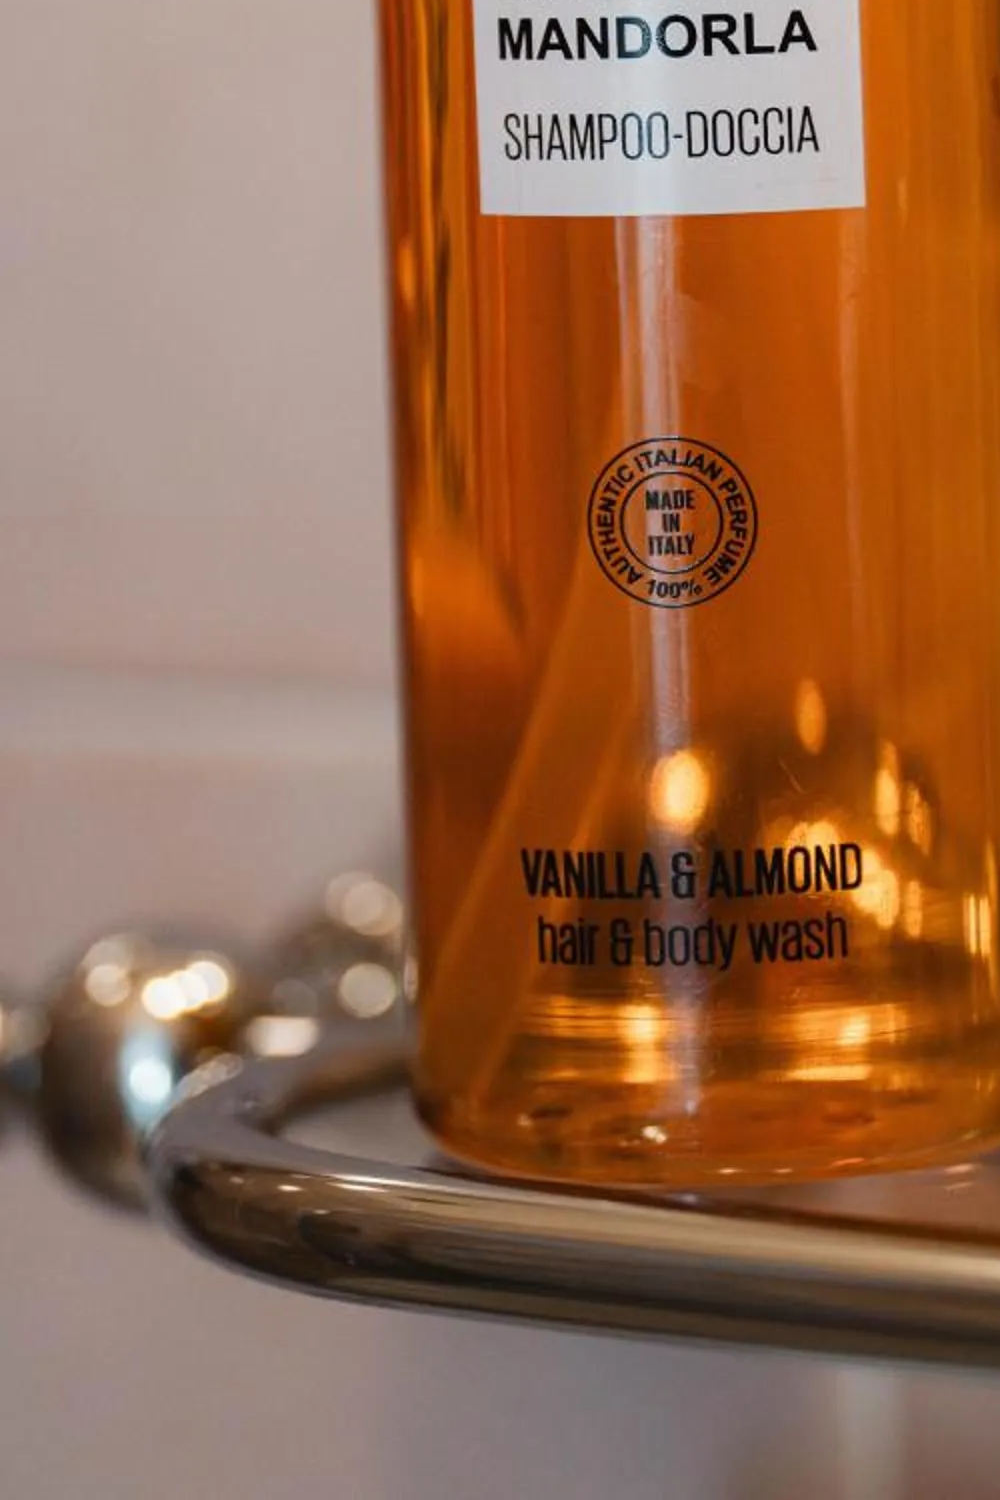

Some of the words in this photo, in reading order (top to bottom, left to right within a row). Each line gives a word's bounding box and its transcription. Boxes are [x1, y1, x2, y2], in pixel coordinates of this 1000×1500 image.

[498, 10, 817, 60] MANDORLA
[504, 106, 820, 160] SHAMPOO-DOCCIA
[597, 464, 642, 585] AUTHENTIC
[634, 448, 724, 482] ITALIAN
[702, 478, 748, 586] PERFUME
[645, 490, 695, 510] MADE
[662, 513, 680, 533] IN
[648, 535, 696, 556] ITALY
[647, 579, 702, 598] 100%
[520, 848, 661, 899] VANILLA
[671, 852, 697, 899] &
[708, 842, 863, 898] ALMOND
[537, 915, 600, 965] hair
[610, 918, 634, 966] &
[644, 915, 737, 971] body
[748, 911, 848, 964] wash
